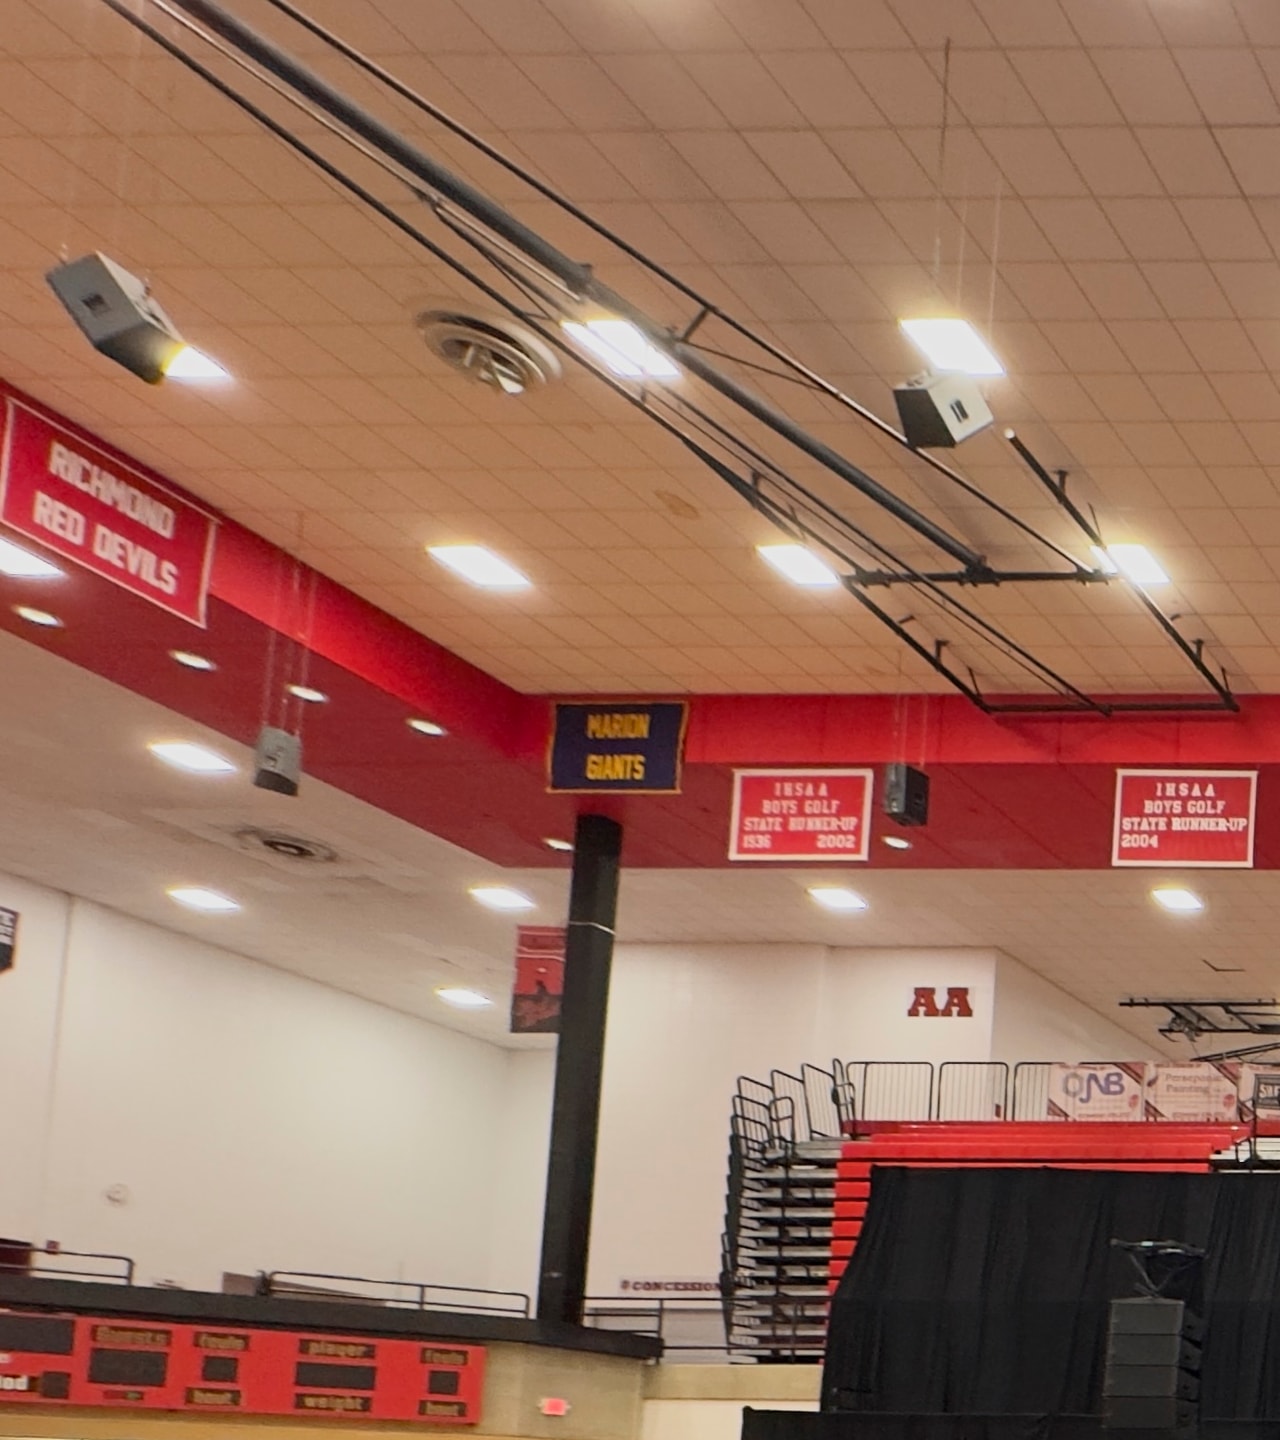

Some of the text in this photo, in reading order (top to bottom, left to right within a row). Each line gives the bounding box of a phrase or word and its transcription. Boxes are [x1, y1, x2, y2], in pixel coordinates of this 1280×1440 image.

[48, 440, 175, 540] RICHMOND
[33, 490, 178, 595] RED DEVILS
[586, 713, 650, 739] MARION
[586, 754, 645, 780] GIANTS
[774, 782, 828, 797] IHSAA
[1156, 782, 1215, 797] IHSAA
[762, 800, 840, 814] BOYS GOLF
[1143, 800, 1226, 814] BOYS GOLF
[743, 817, 858, 831] STATE RUNNER-UP
[1121, 817, 1248, 831] STATE RUNNER-UP
[816, 834, 856, 848] 2002
[1121, 834, 1159, 848] 2004
[907, 987, 973, 1017] AA
